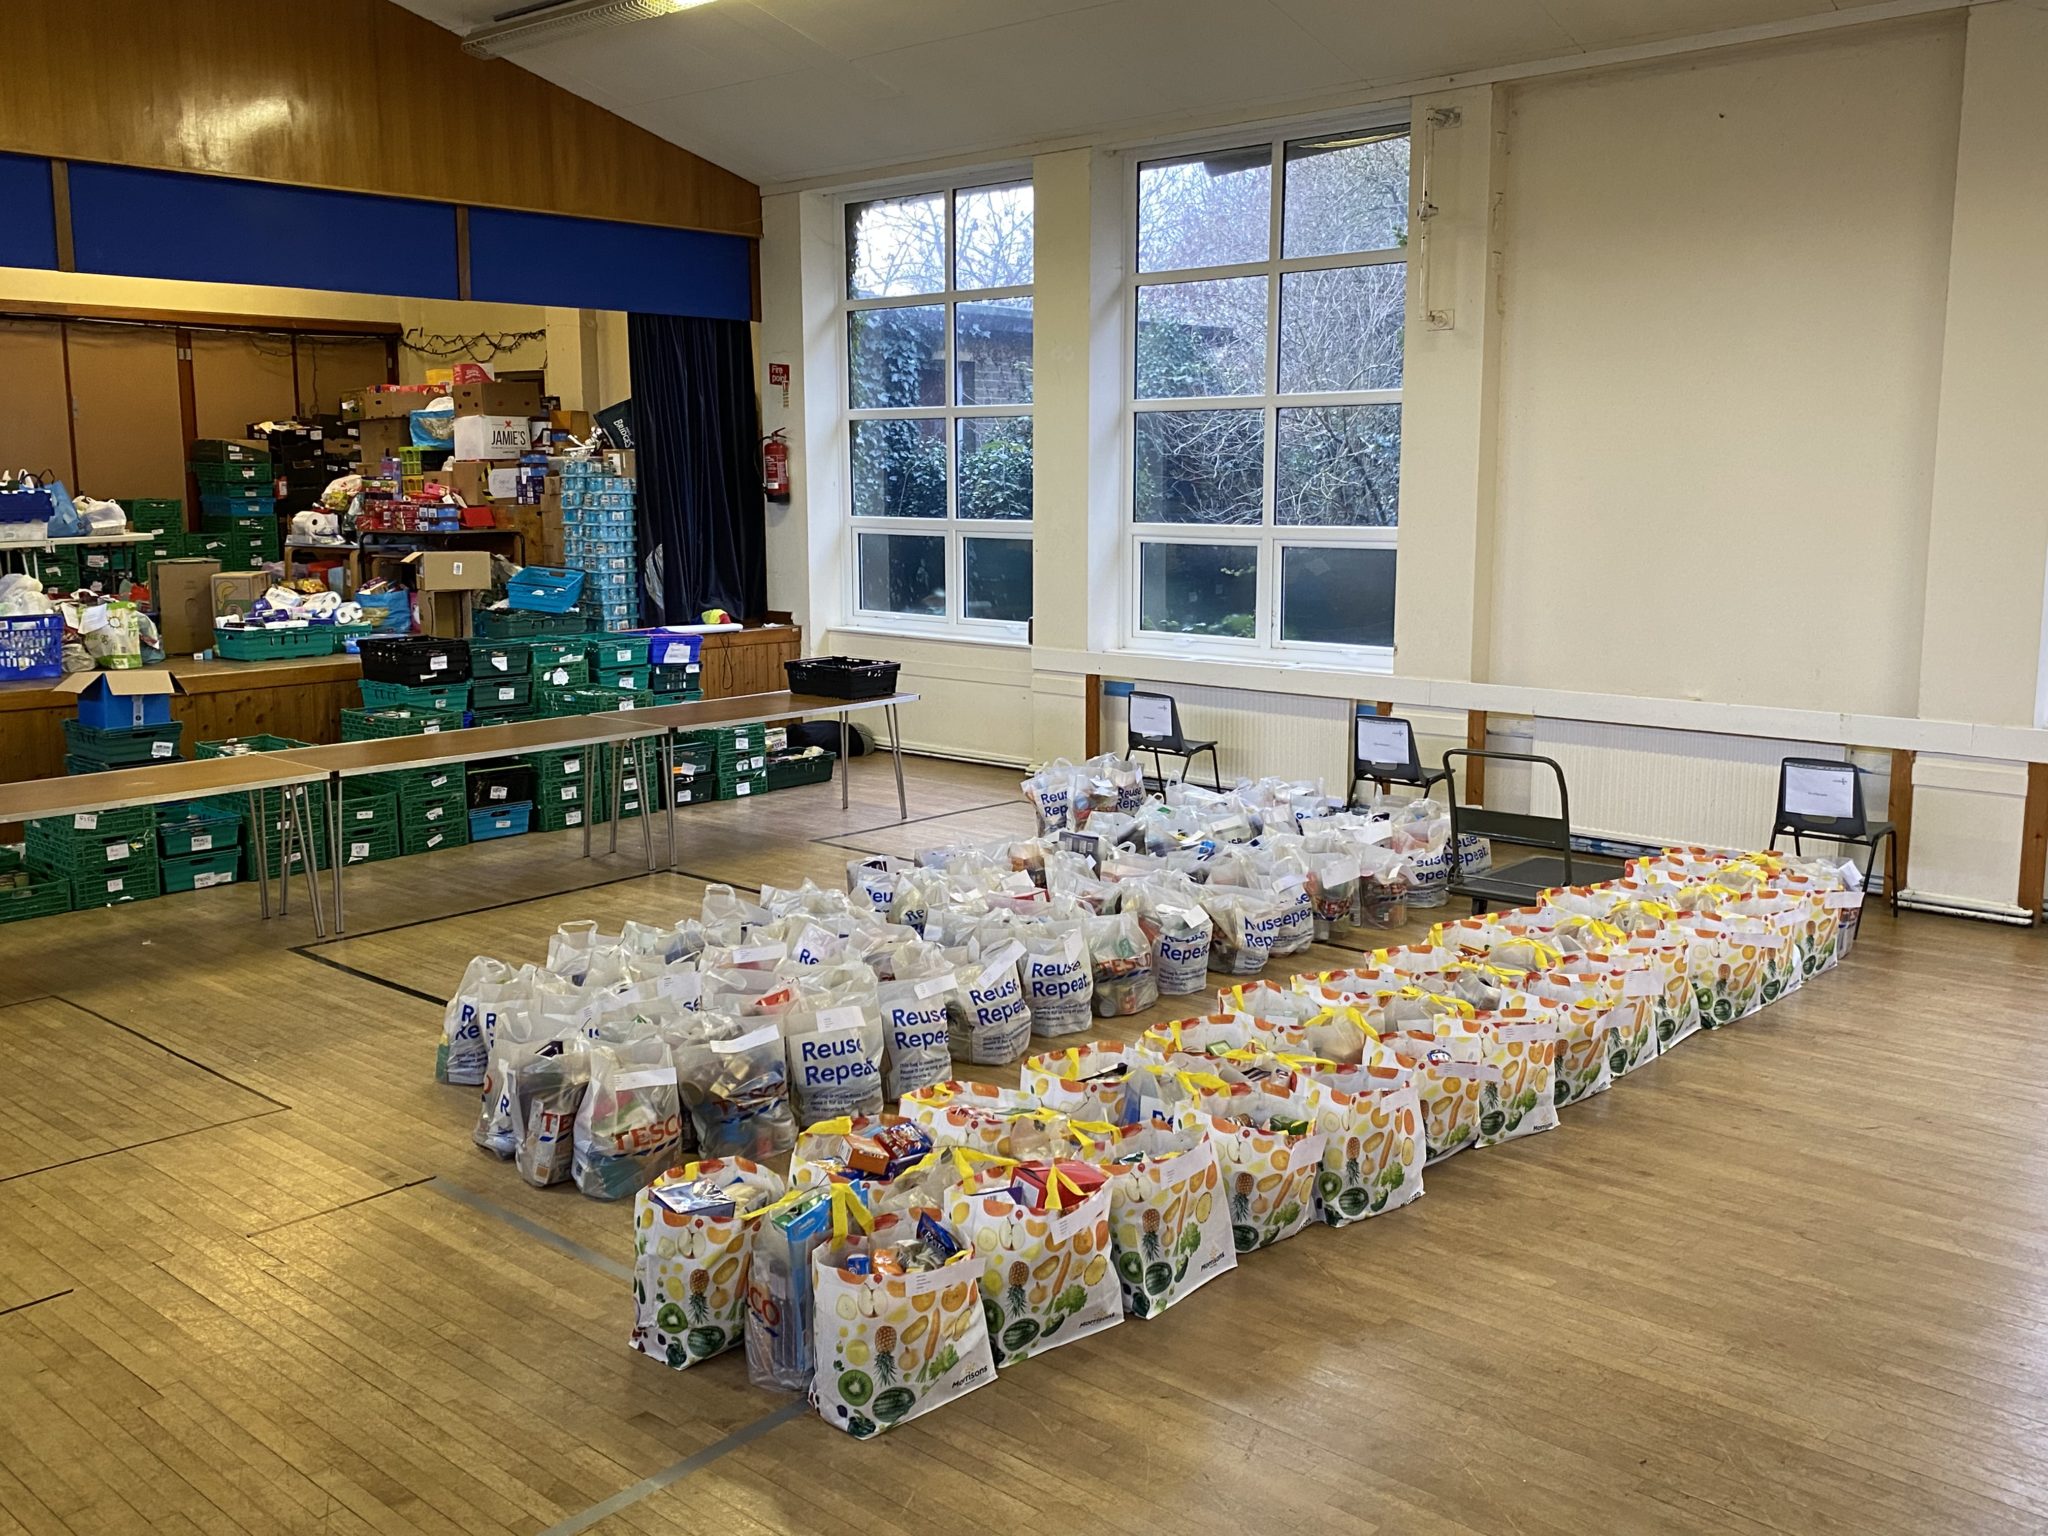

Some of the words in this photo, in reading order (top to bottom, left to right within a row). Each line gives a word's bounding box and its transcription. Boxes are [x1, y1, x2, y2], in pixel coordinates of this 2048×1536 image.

[771, 365, 783, 374] Fire
[491, 430, 526, 446] JAMIE'S
[951, 1365, 988, 1389] Morrisons
